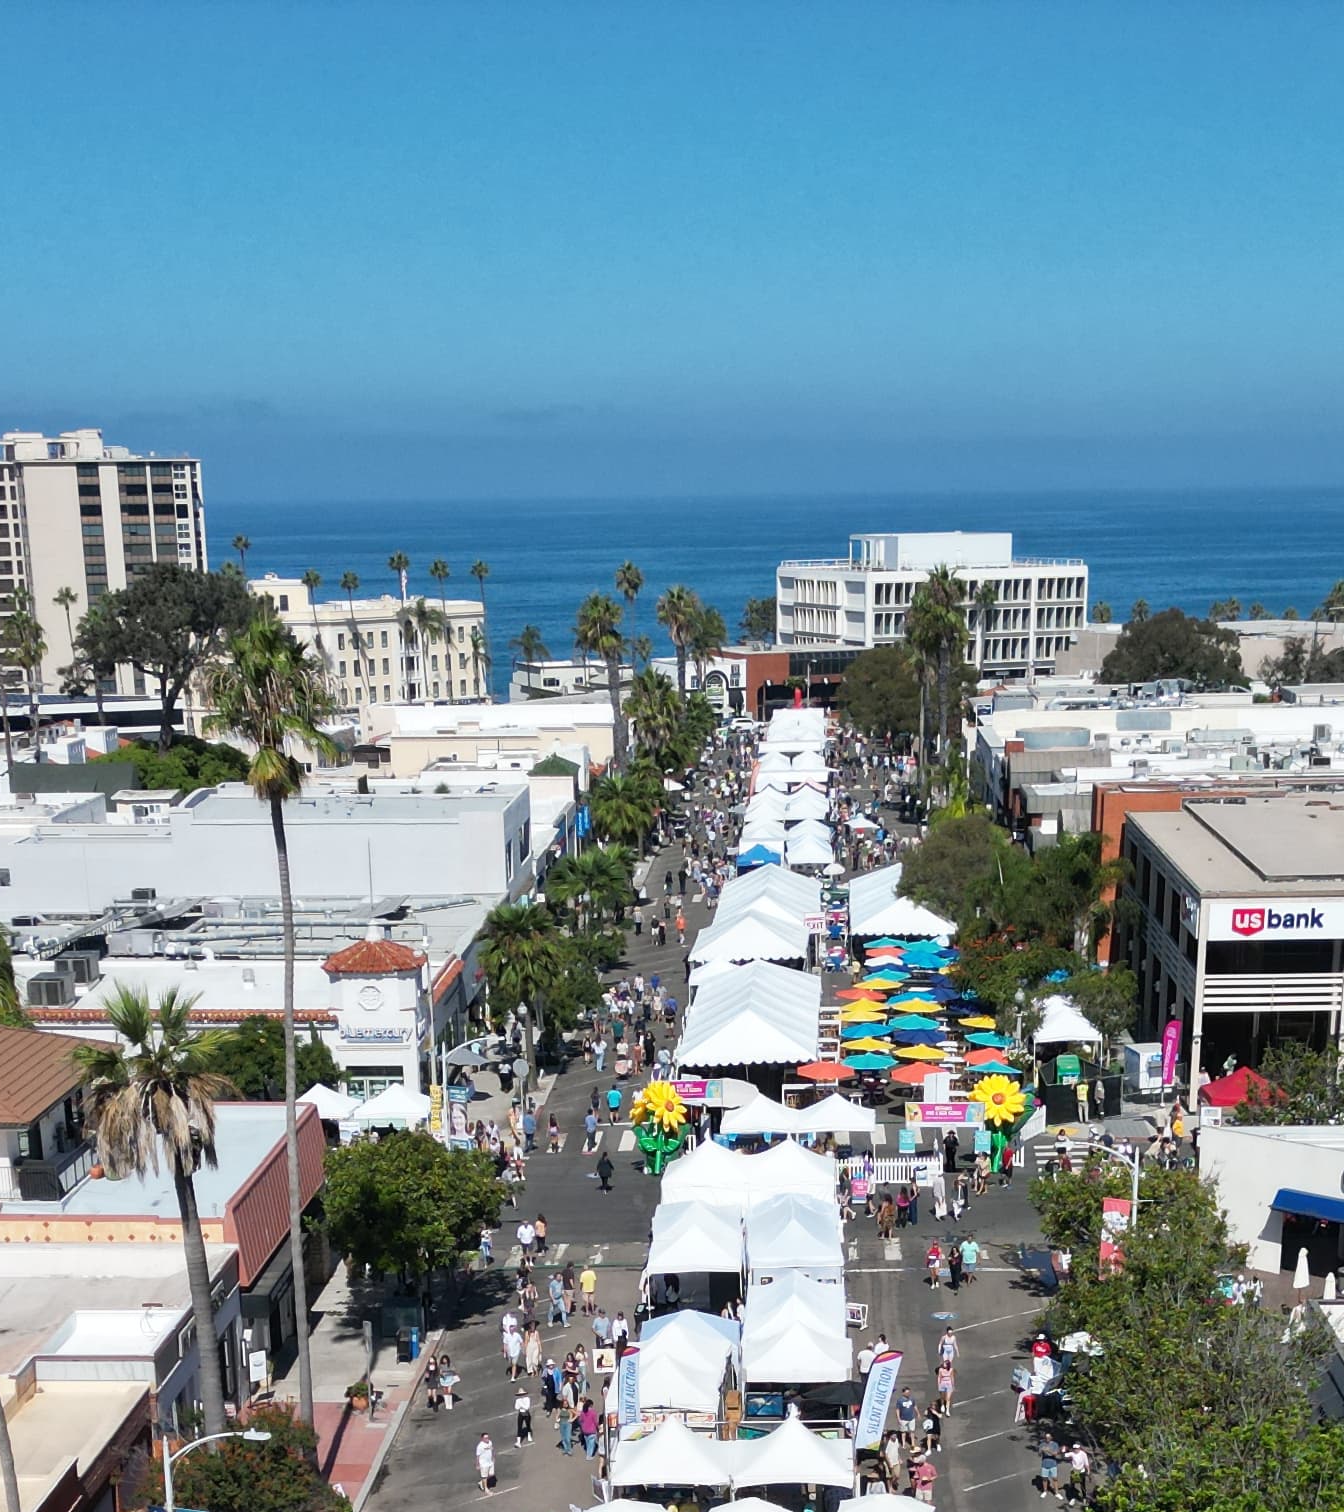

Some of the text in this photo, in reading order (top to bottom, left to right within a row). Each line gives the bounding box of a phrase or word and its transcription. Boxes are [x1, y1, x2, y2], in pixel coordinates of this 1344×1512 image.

[1234, 907, 1324, 930] us bank
[338, 1025, 413, 1042] bluemercury
[624, 1360, 637, 1399] AUCTION
[866, 1366, 894, 1436] SILENT AUCTION
